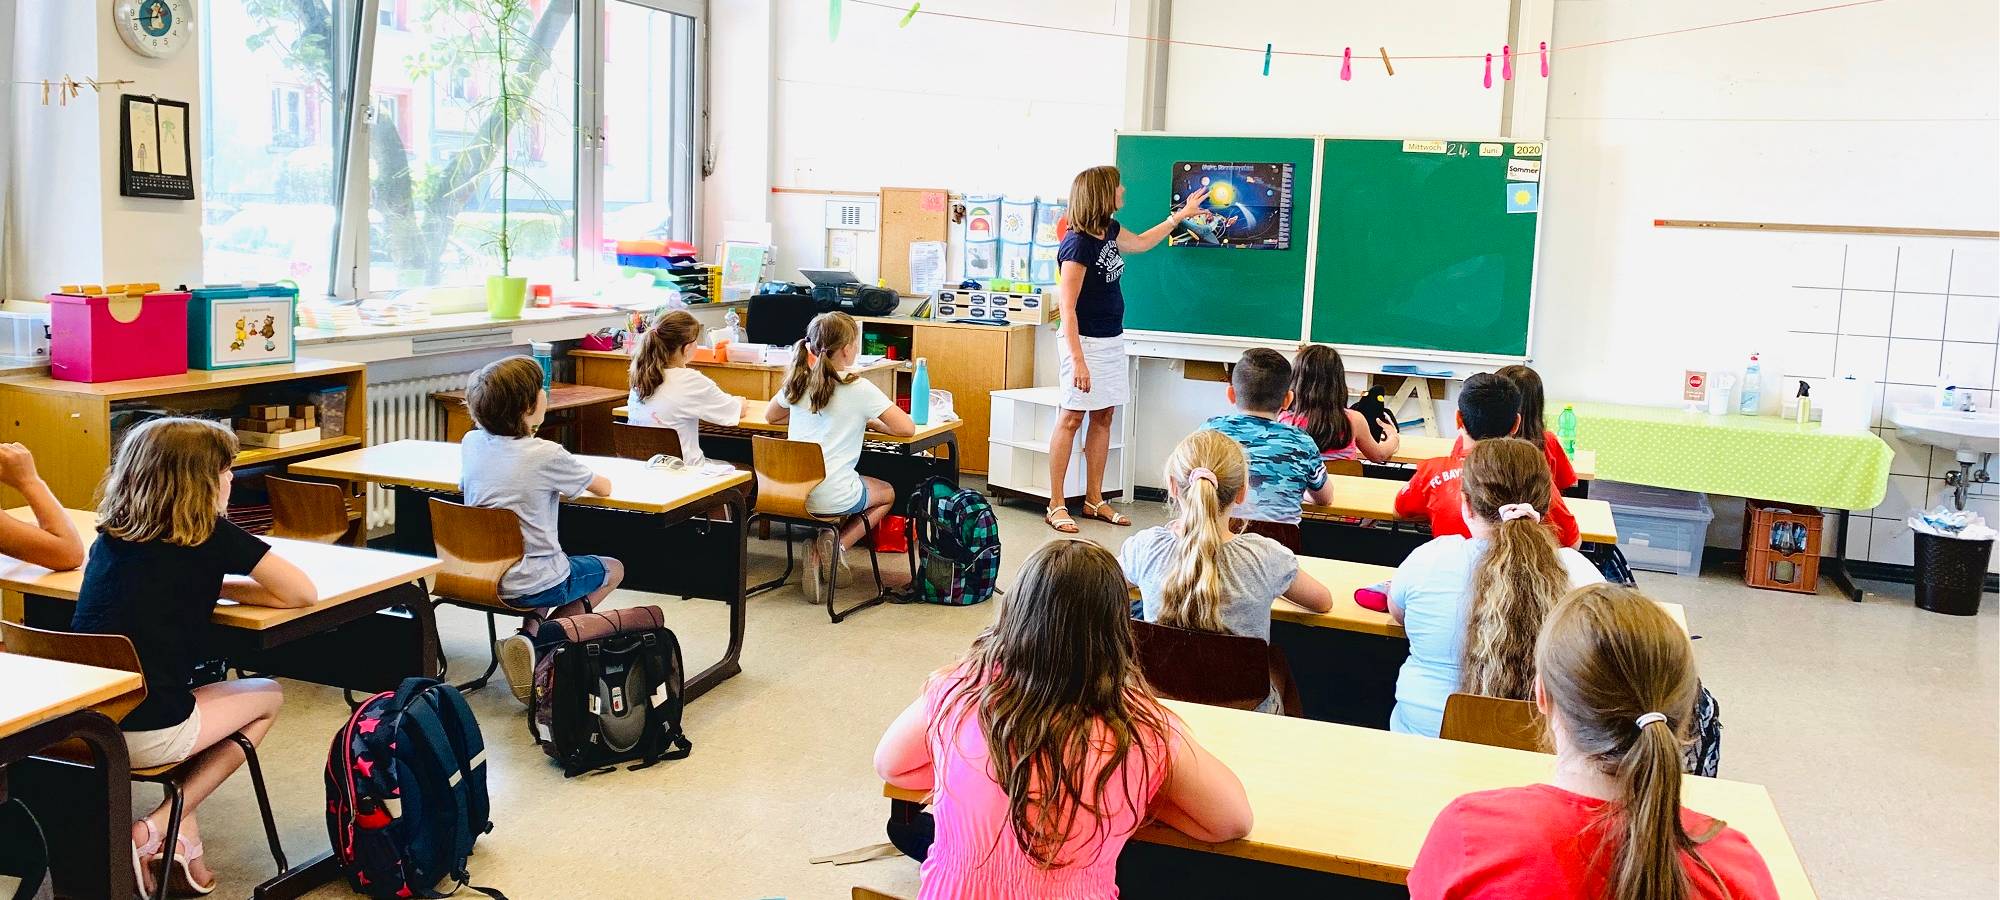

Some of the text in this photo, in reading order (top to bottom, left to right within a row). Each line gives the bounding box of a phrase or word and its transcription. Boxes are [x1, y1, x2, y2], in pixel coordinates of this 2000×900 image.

[152, 39, 157, 47] 6
[1408, 143, 1442, 151] Mittwoch
[1447, 143, 1471, 158] 24.
[1516, 146, 1540, 154] 2020
[1509, 165, 1538, 174] Sommer
[1430, 468, 1464, 489] FC BAY
